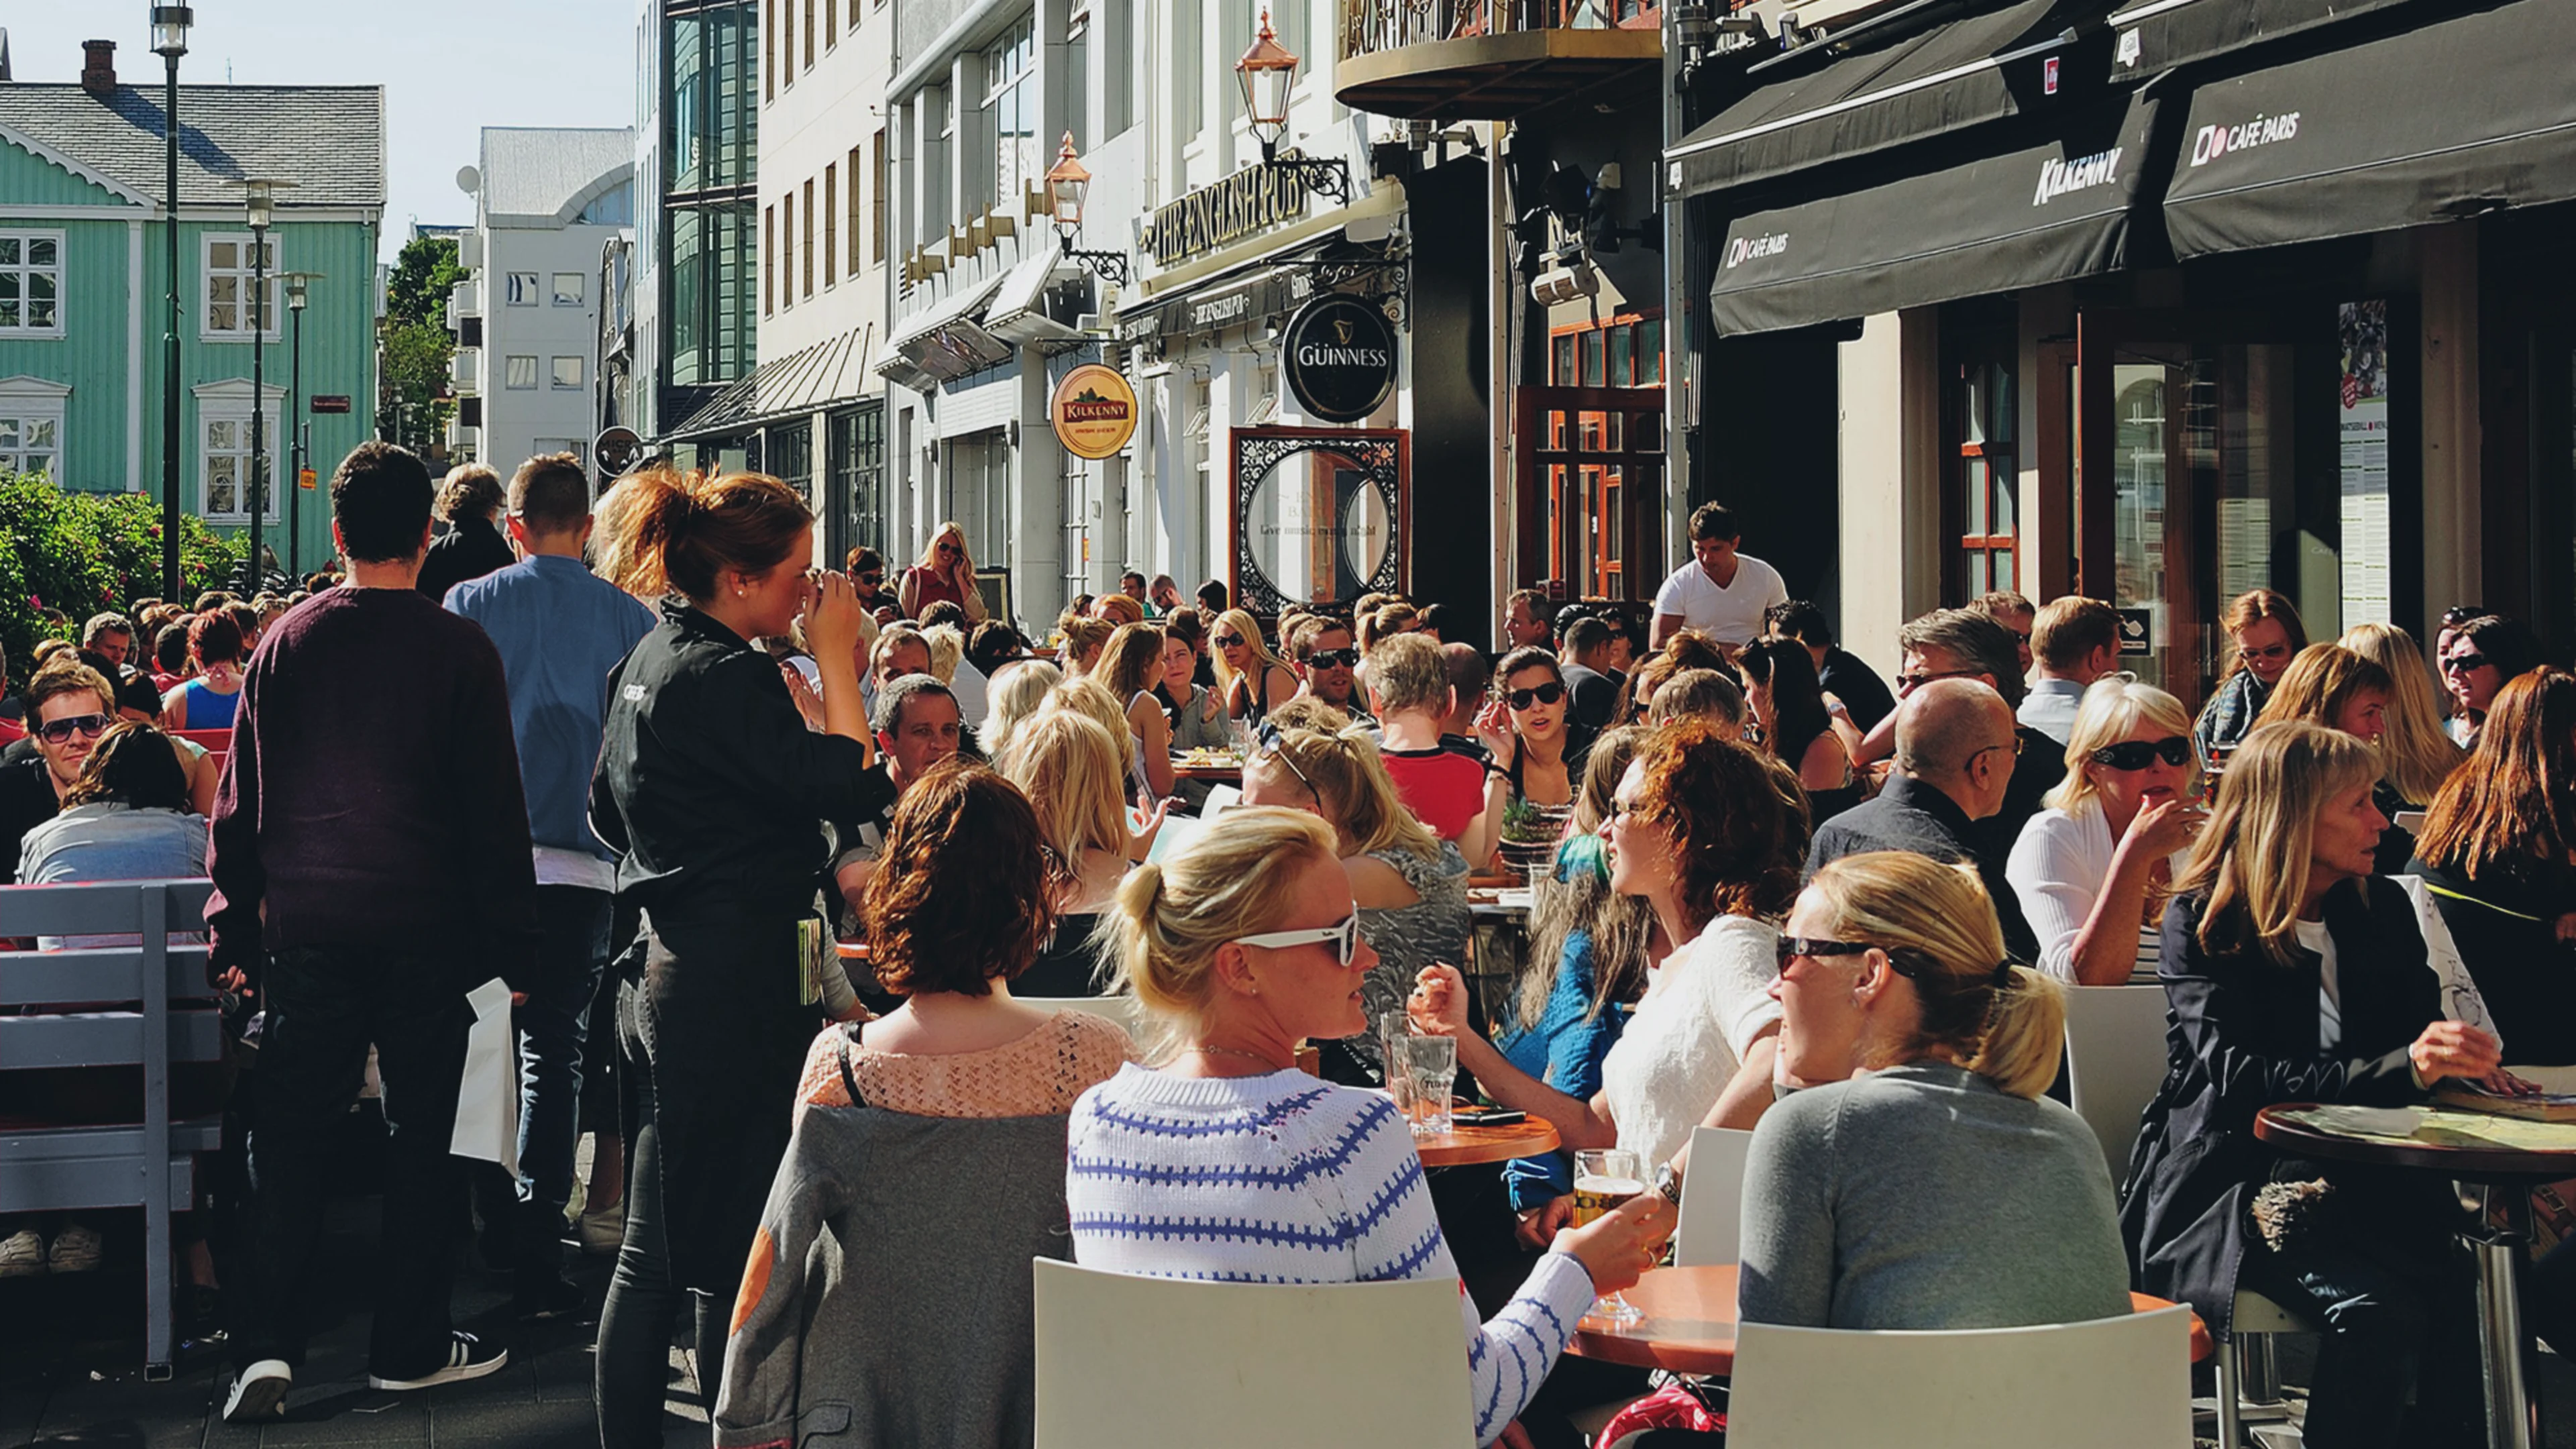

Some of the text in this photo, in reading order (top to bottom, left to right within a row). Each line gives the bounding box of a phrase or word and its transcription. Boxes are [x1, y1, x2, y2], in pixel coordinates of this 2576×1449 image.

[2226, 111, 2301, 152] CAFÉ PARIS
[1154, 200, 1184, 266] THE
[1184, 165, 1261, 254] ENGLISH
[1067, 405, 1126, 418] KILKENNY
